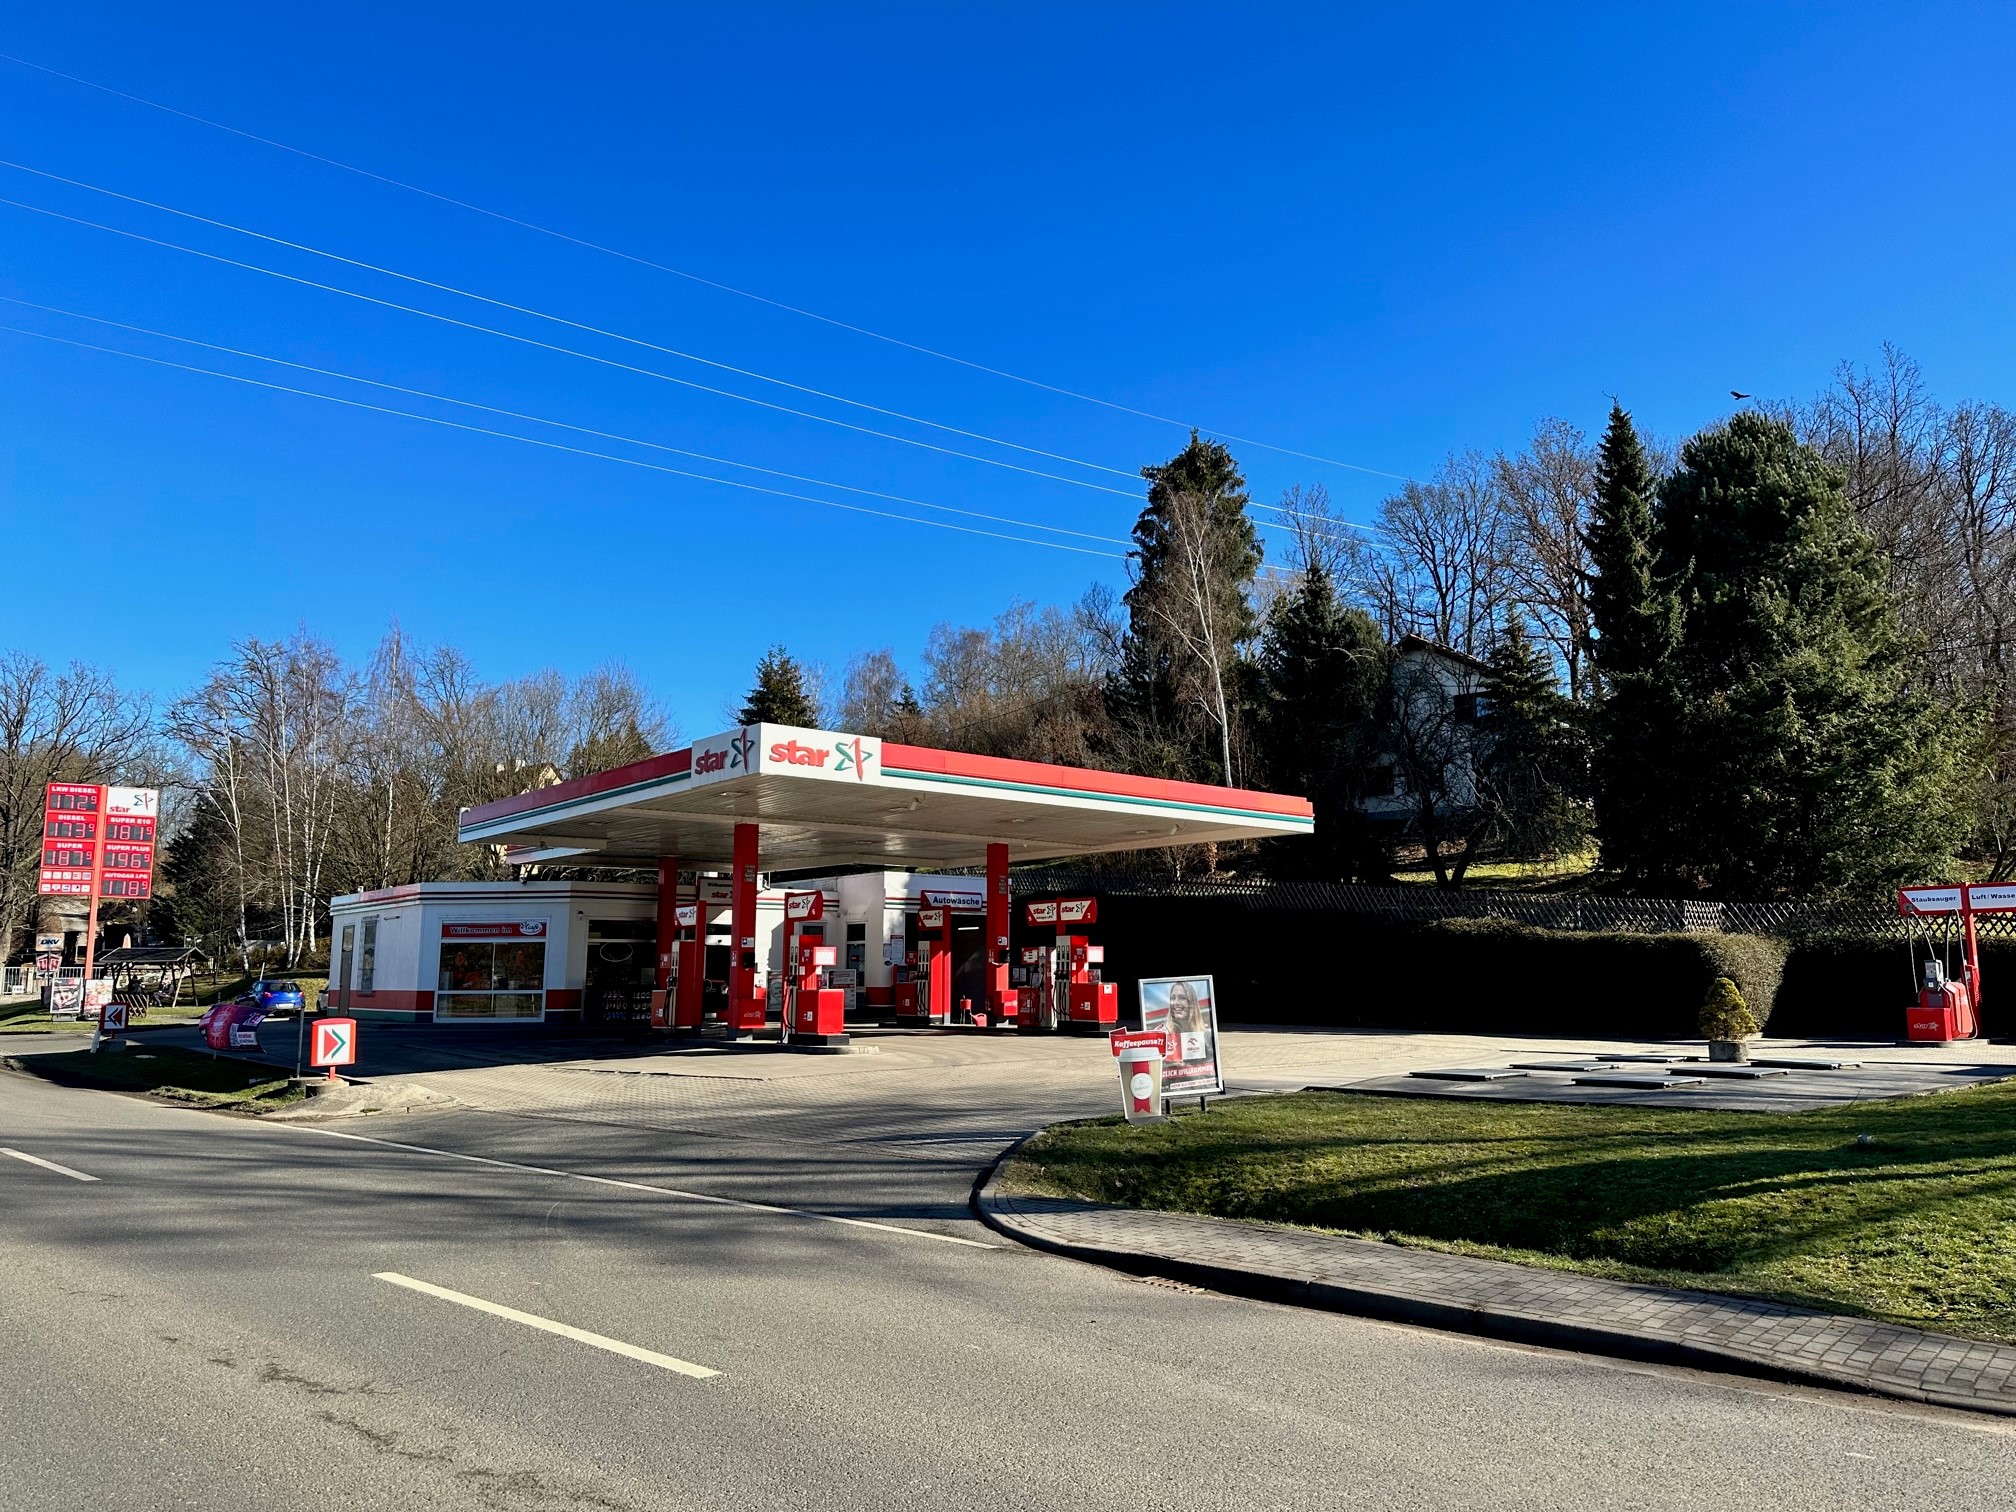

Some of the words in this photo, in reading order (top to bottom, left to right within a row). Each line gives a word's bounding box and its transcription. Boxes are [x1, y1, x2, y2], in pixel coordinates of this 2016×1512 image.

[769, 740, 829, 767] star
[694, 749, 728, 775] star
[109, 805, 130, 813] star
[933, 896, 979, 905] Autowäsche
[788, 901, 801, 909] star
[450, 927, 500, 935] Willkommen
